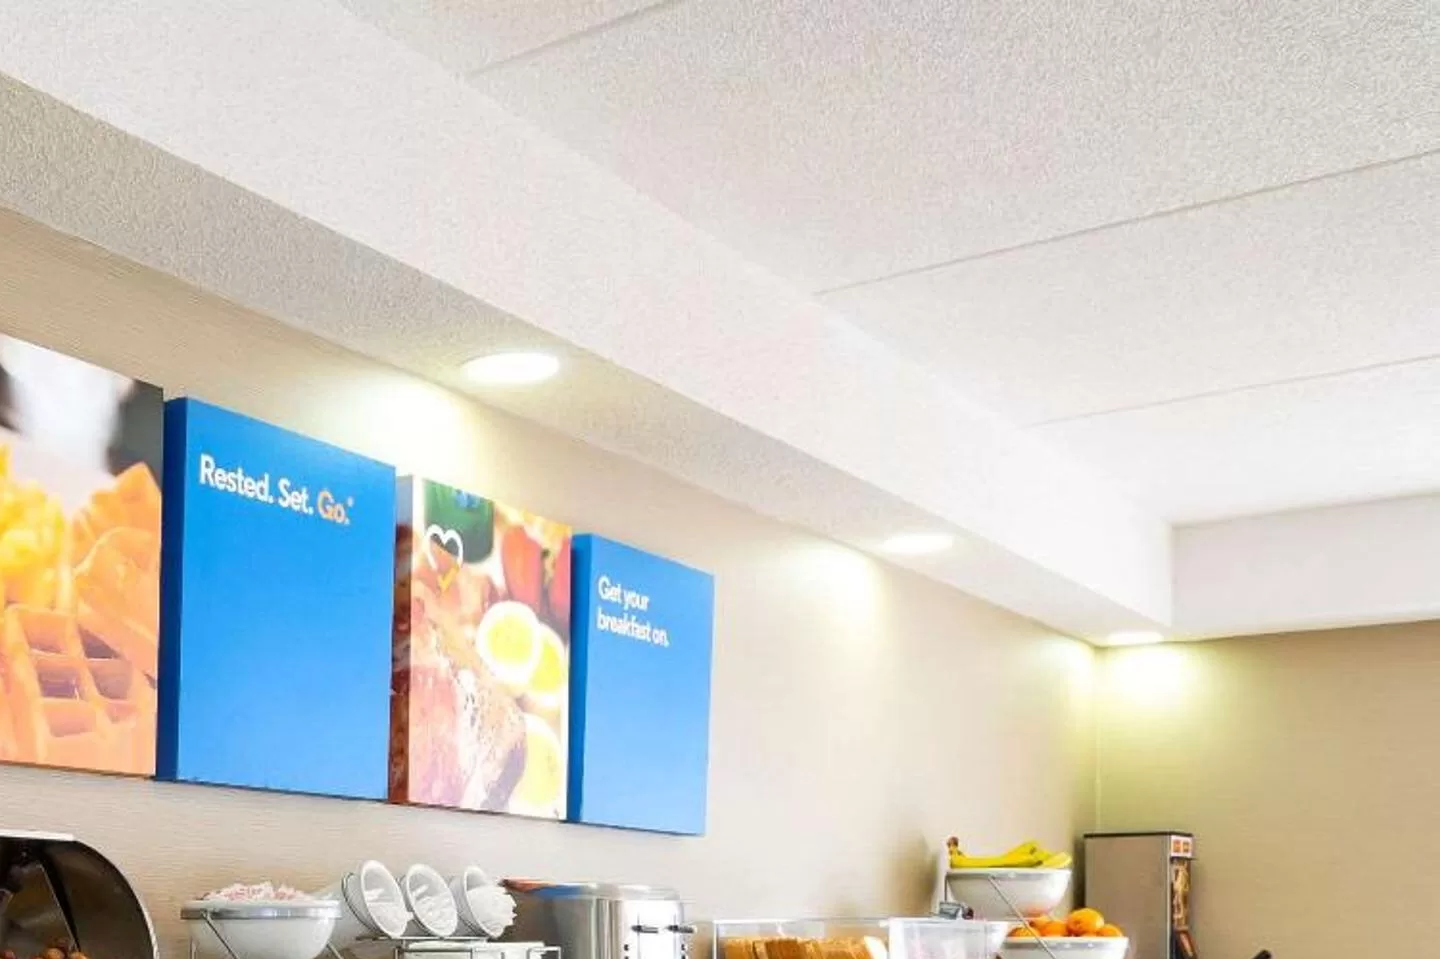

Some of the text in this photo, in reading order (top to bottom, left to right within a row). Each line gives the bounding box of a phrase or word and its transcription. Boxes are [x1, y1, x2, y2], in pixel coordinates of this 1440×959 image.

[199, 453, 274, 504] Rested.
[278, 477, 314, 515] Set.
[598, 575, 650, 611] Get your
[596, 606, 670, 648] breakfast on.
